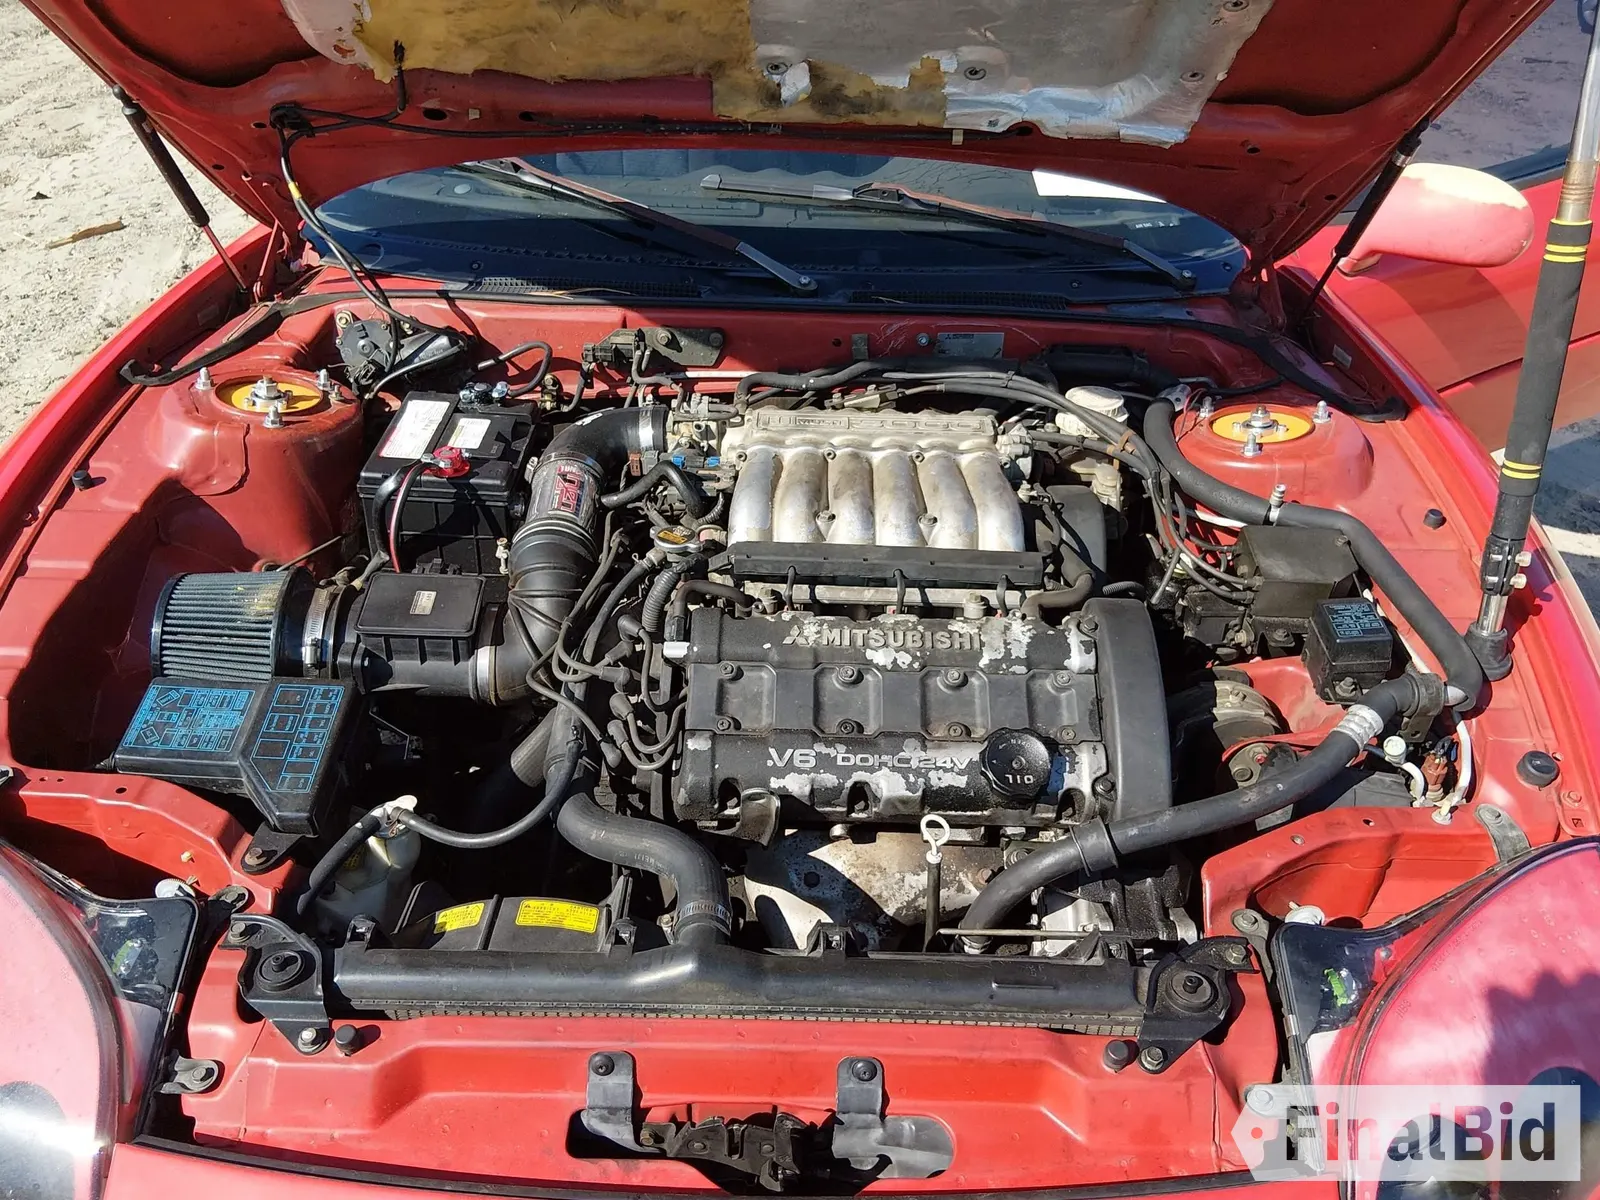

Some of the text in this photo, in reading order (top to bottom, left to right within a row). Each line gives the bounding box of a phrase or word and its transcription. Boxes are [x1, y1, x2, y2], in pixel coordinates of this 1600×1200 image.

[822, 627, 982, 651] MITSUBISHI
[768, 748, 817, 768] V6
[836, 753, 911, 769] DOHC
[1005, 774, 1034, 784] OIL
